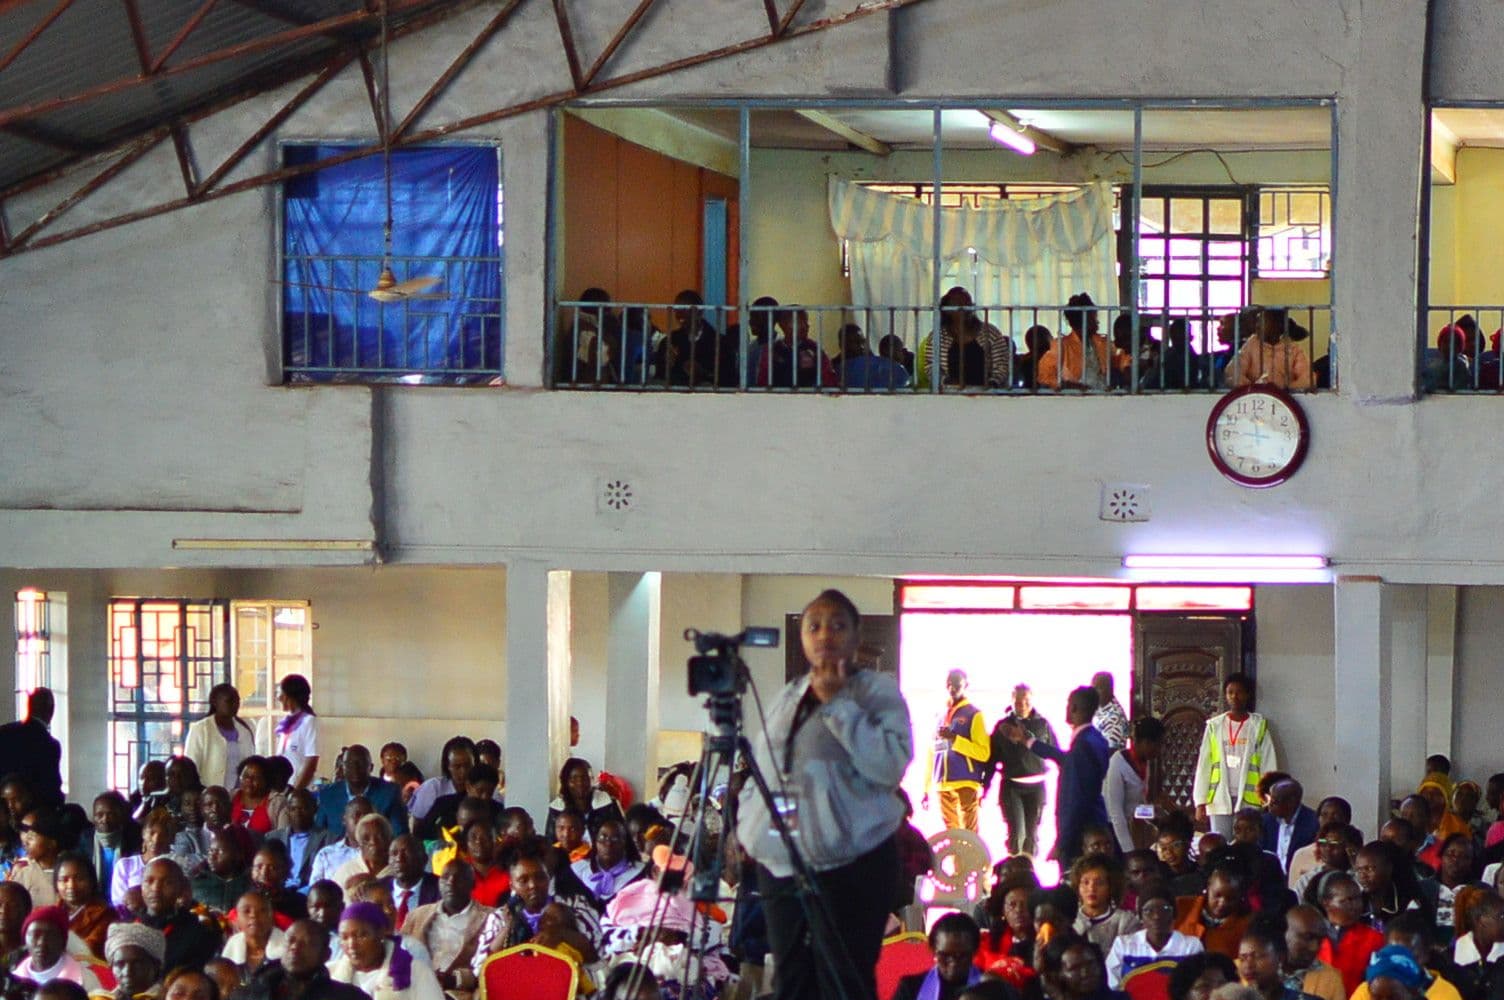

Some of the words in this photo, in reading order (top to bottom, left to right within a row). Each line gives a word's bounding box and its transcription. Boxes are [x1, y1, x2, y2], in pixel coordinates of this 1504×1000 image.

[1237, 402, 1247, 414] 11
[1252, 399, 1265, 411] 12
[1280, 416, 1288, 427] 2
[1222, 429, 1231, 441] 9
[1237, 456, 1245, 469] 7
